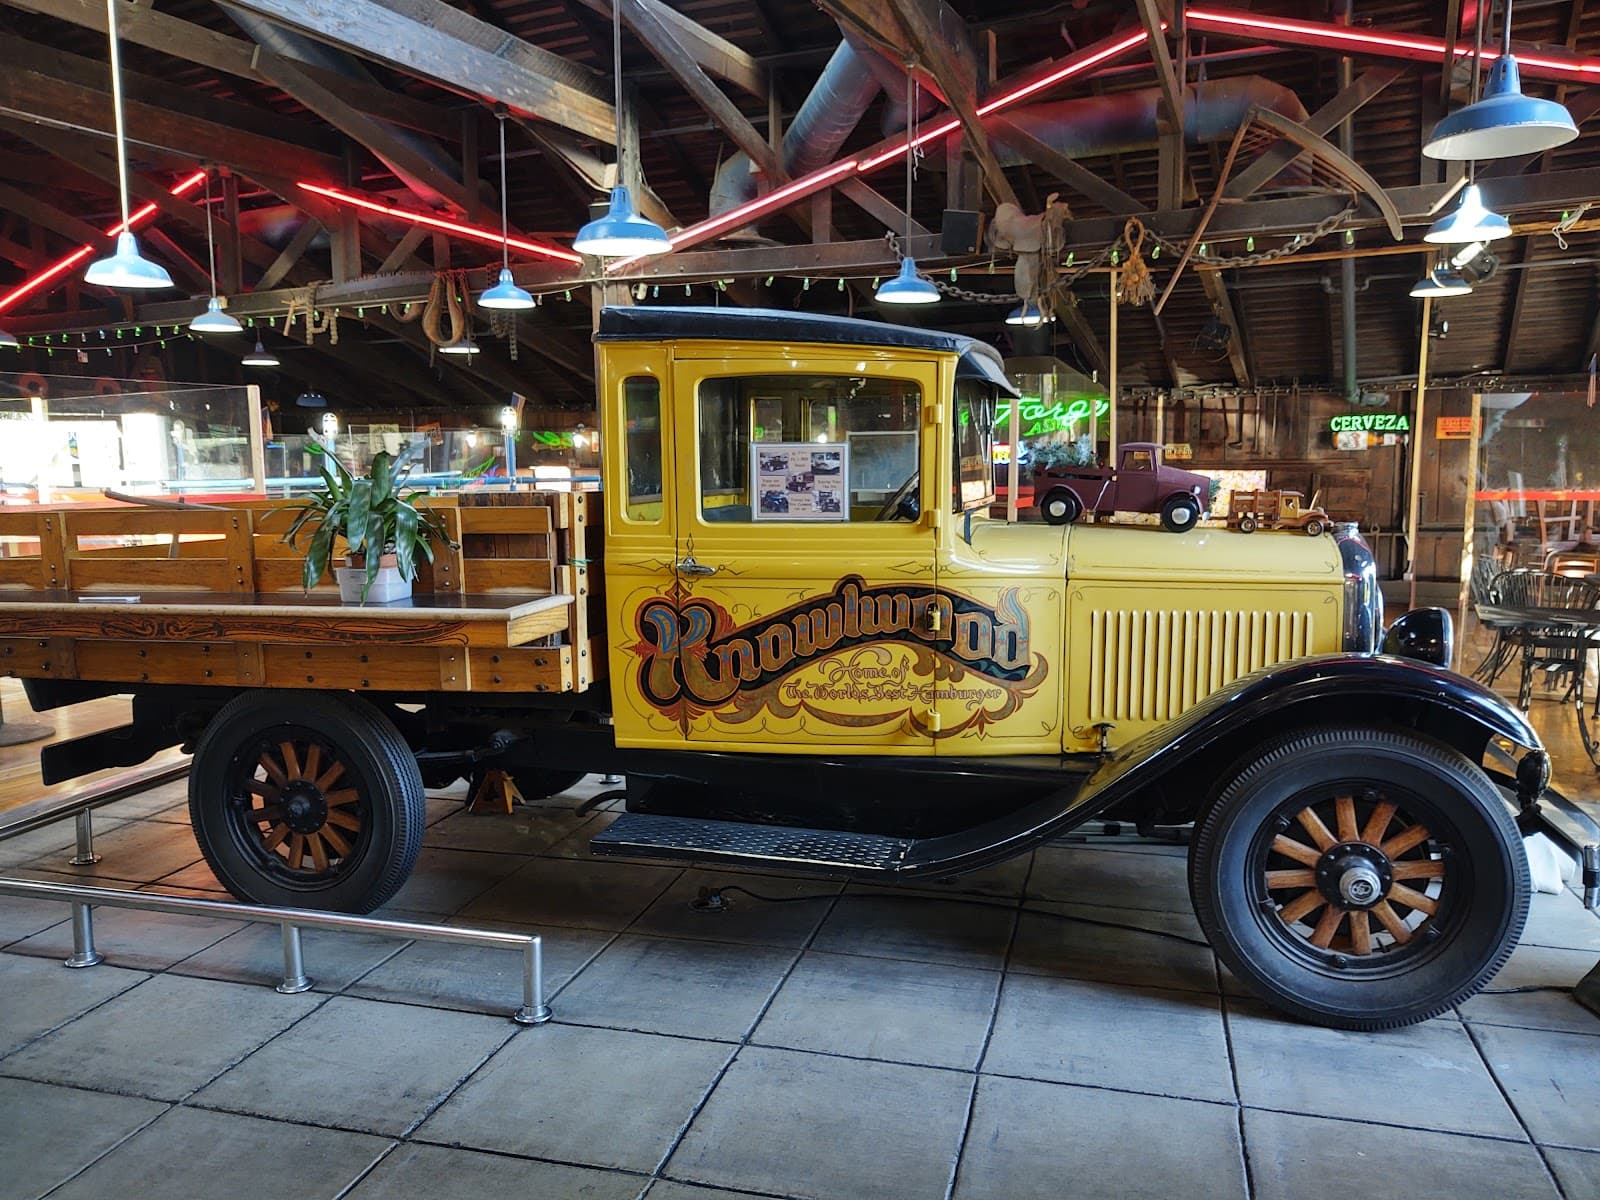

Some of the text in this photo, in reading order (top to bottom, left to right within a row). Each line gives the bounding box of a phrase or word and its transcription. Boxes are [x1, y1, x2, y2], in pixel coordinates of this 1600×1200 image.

[1331, 415, 1409, 431] CERVEZA
[644, 584, 1031, 701] Knowlwood
[890, 654, 909, 684] of
[867, 681, 908, 701] Best
[907, 682, 1001, 710] Hamburger
